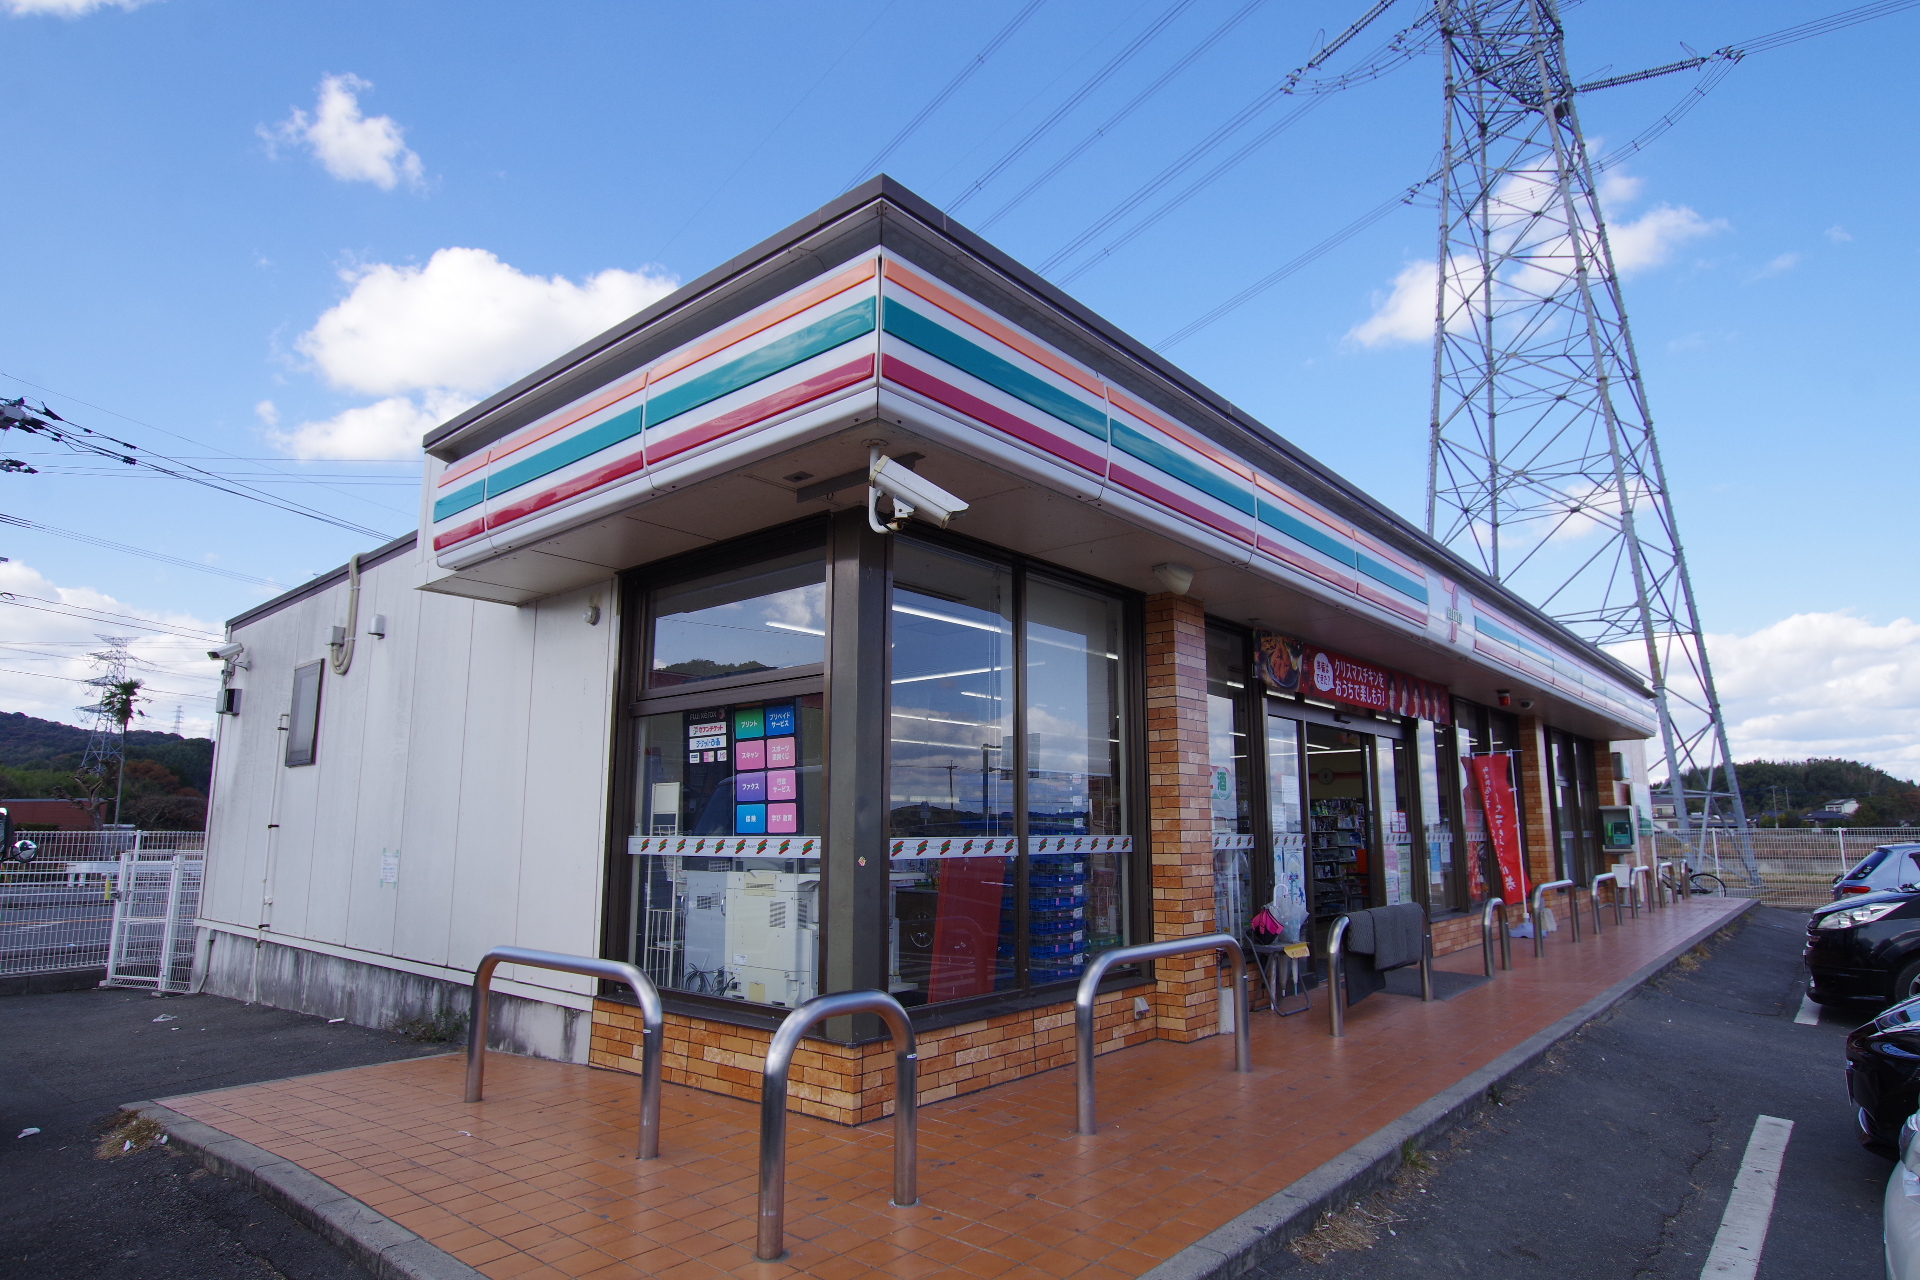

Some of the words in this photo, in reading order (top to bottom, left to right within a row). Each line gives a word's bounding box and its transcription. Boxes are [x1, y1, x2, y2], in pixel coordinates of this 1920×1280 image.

[1334, 659, 1385, 688] クリスマスチキンを
[769, 712, 790, 720] プリペイド
[740, 719, 758, 728] プリント
[772, 720, 789, 728] サービス
[771, 745, 790, 753] スポーツ
[741, 751, 760, 759] スキャン
[1216, 771, 1227, 792] 酒
[742, 783, 760, 791] ファクス
[772, 785, 791, 793] サービス
